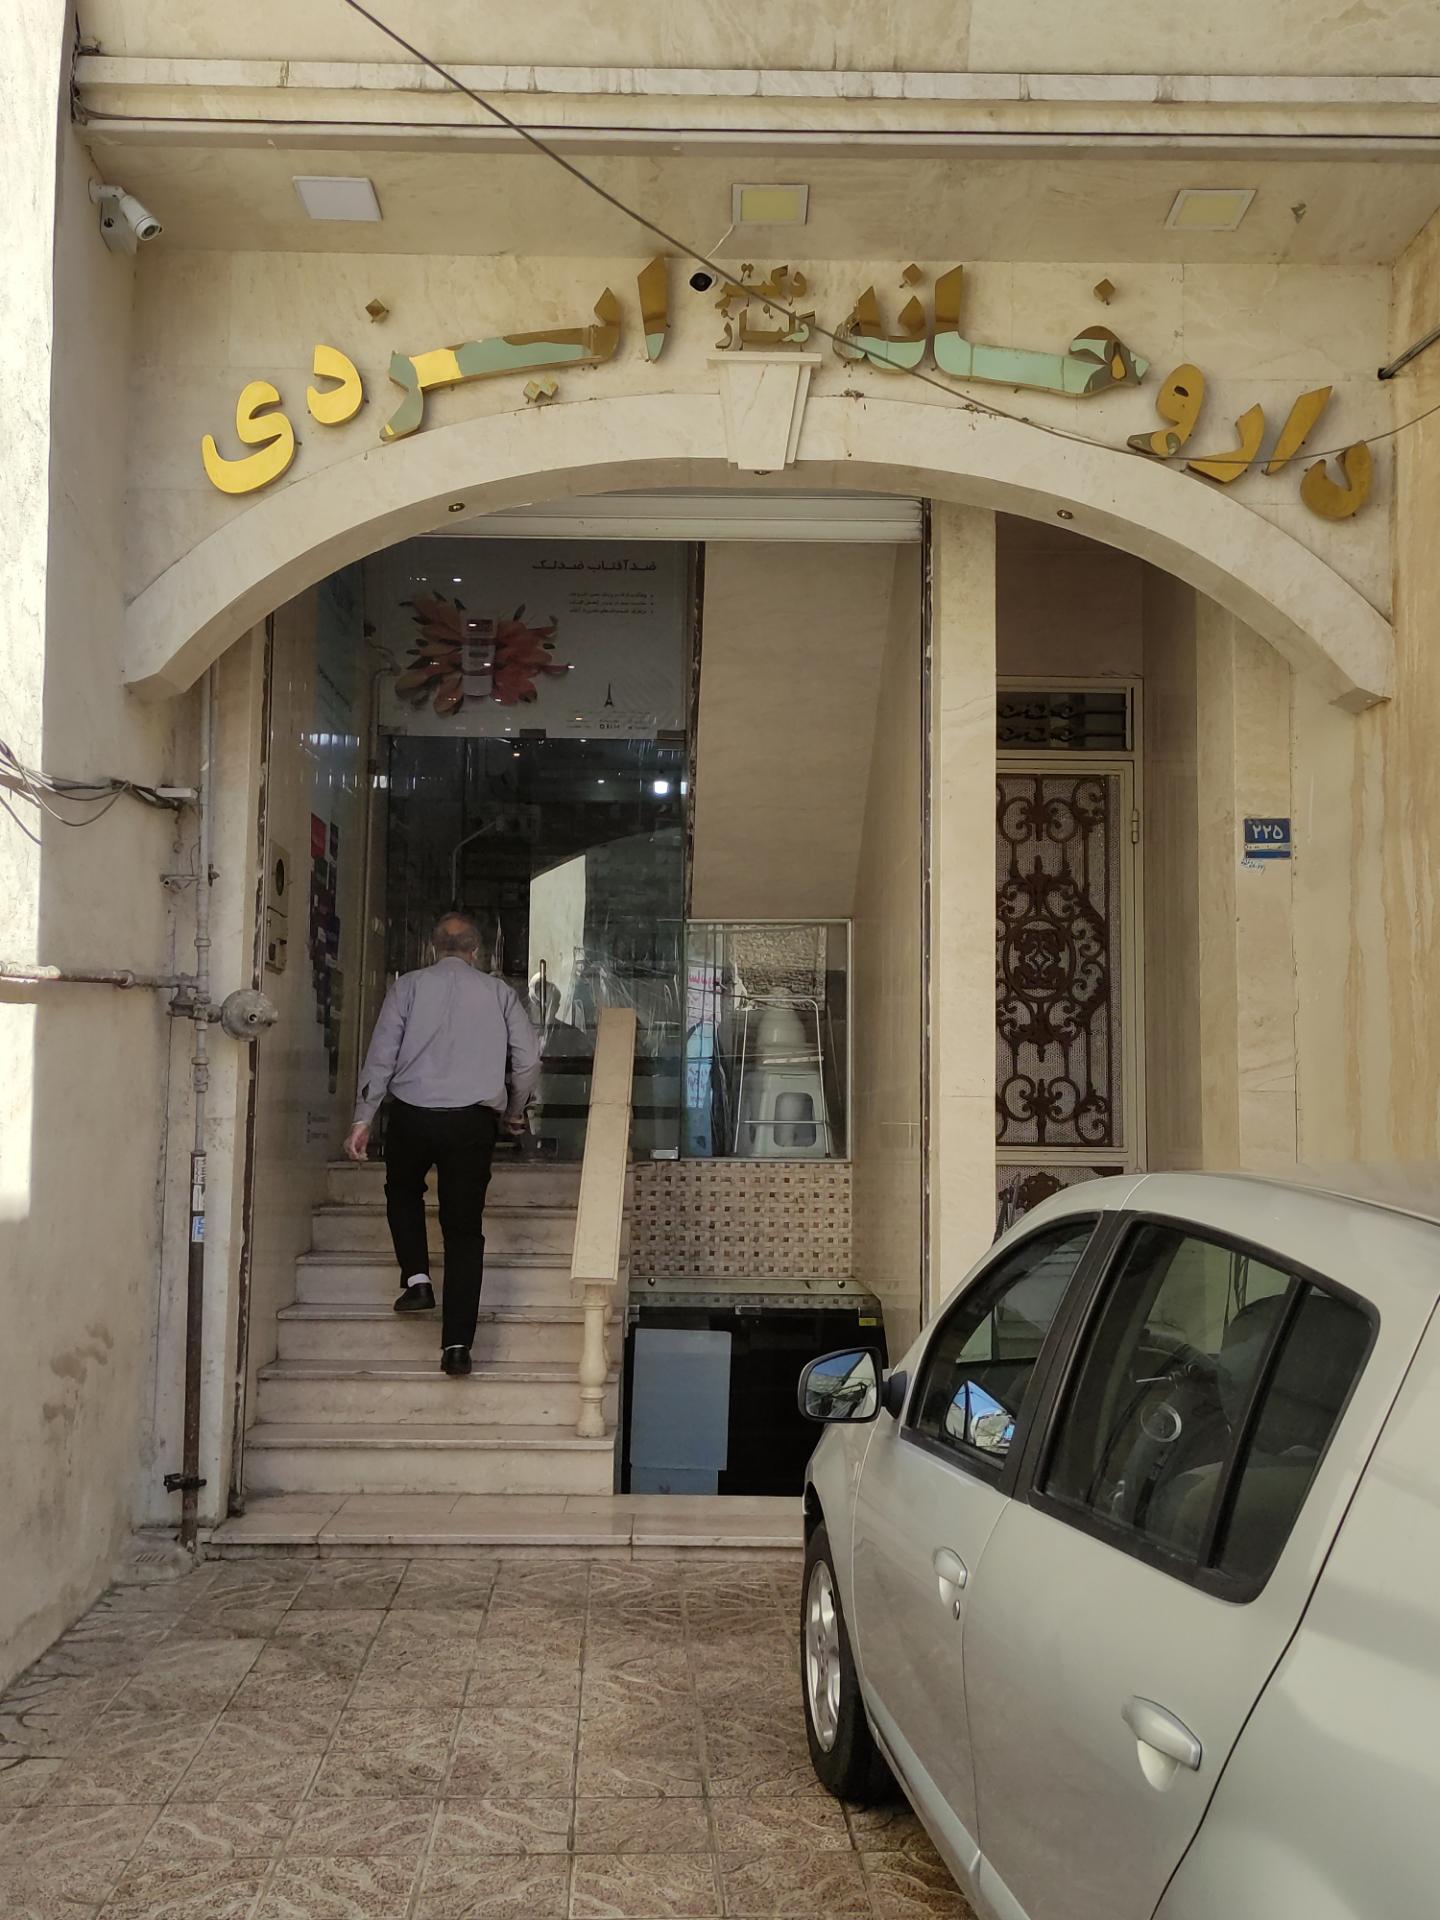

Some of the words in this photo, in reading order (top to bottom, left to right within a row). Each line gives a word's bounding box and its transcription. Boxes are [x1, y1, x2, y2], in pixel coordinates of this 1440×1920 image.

[714, 263, 807, 309] دکتر
[202, 256, 668, 495] ایزدی
[832, 264, 1373, 522] داروخانه
[1252, 824, 1284, 840] ۲۲۵
